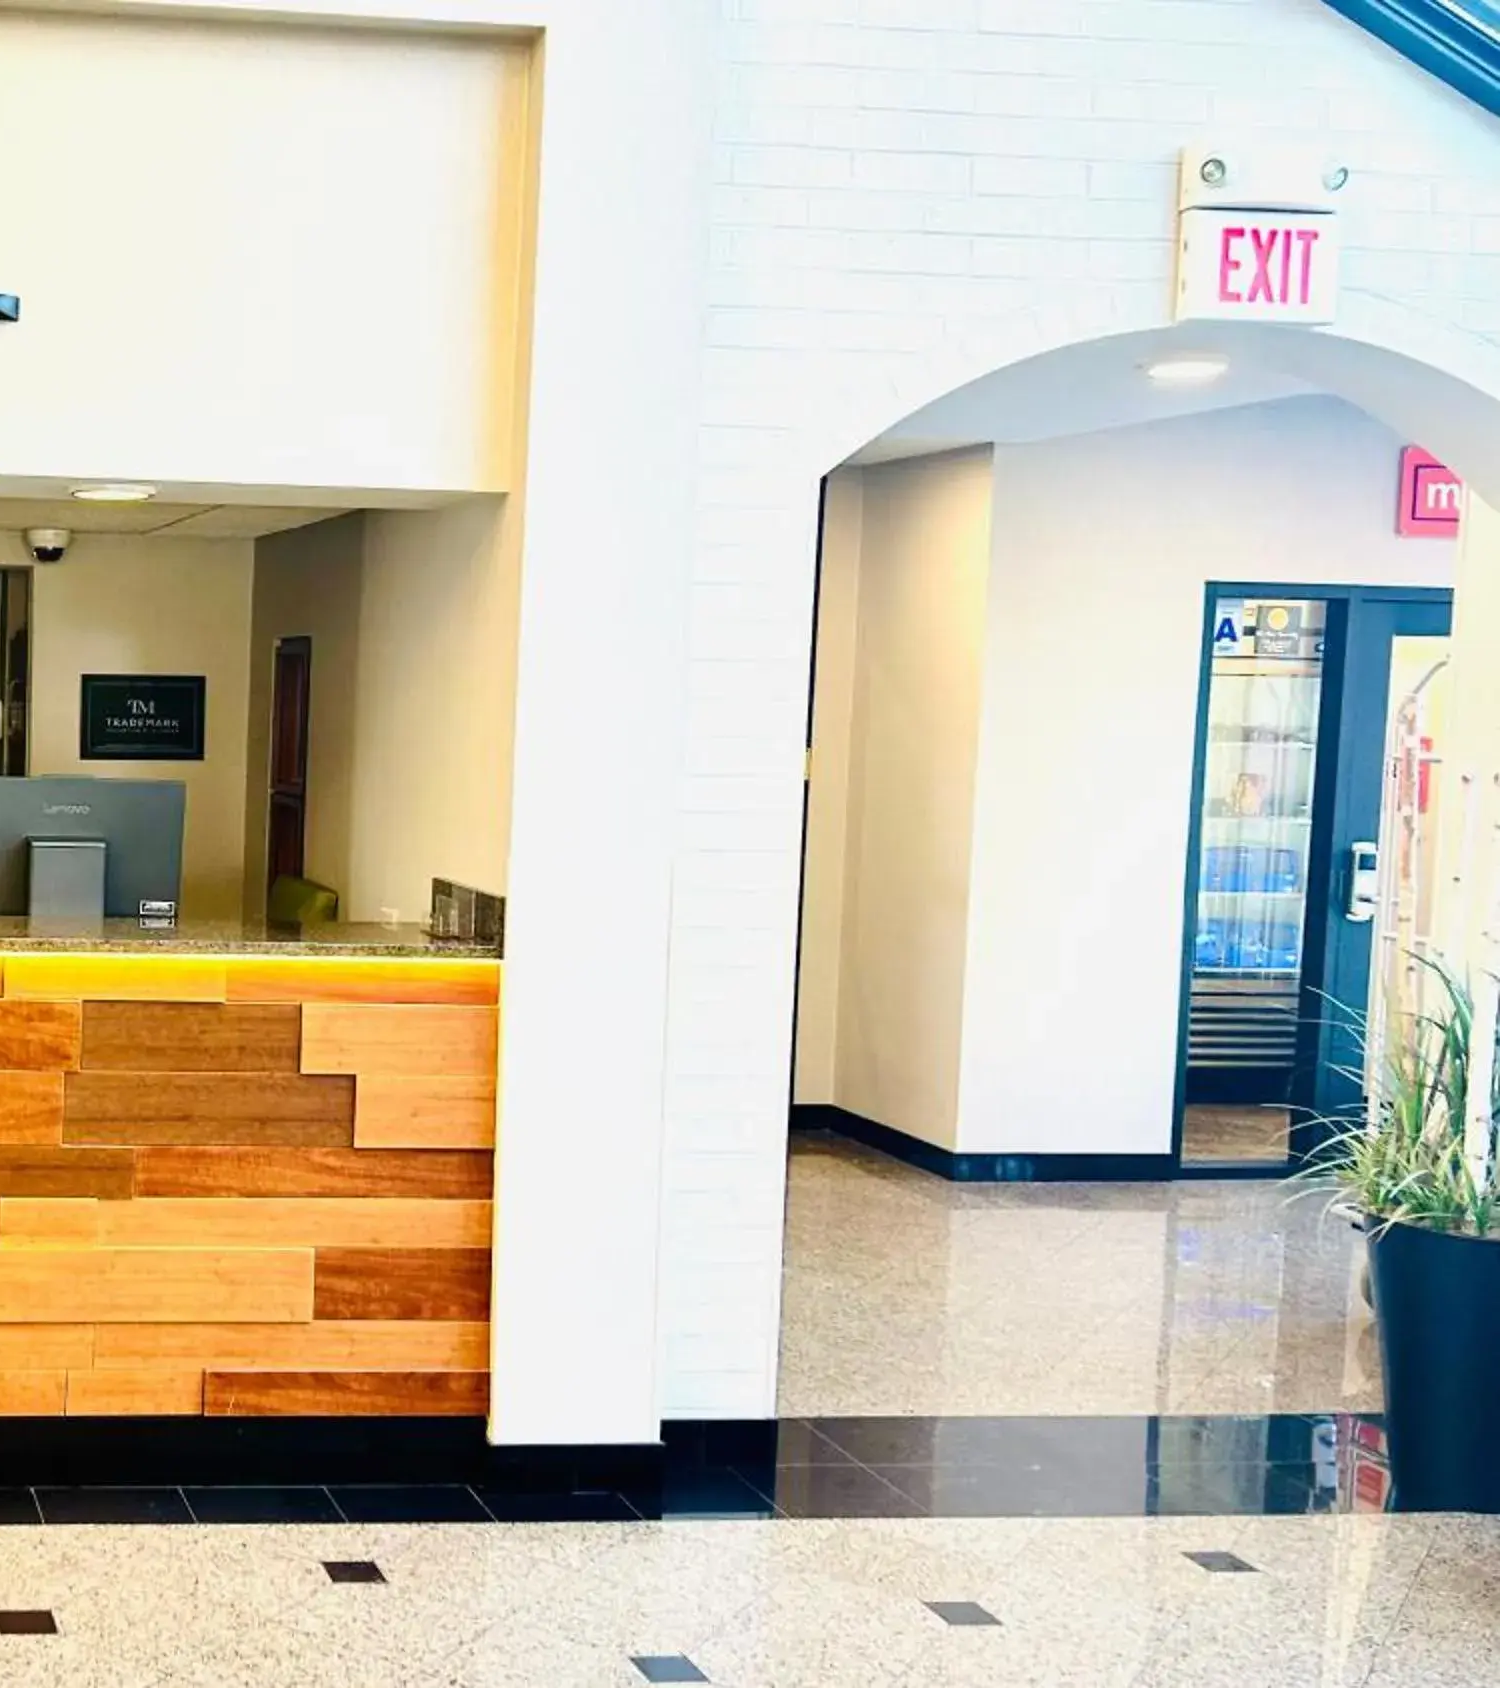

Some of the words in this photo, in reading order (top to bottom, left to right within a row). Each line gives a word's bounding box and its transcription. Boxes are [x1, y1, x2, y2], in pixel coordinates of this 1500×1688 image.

[1218, 227, 1319, 304] EXIT
[1214, 616, 1238, 642] A
[105, 717, 180, 727] TRADEMARK
[43, 802, 91, 815] Lenovo
